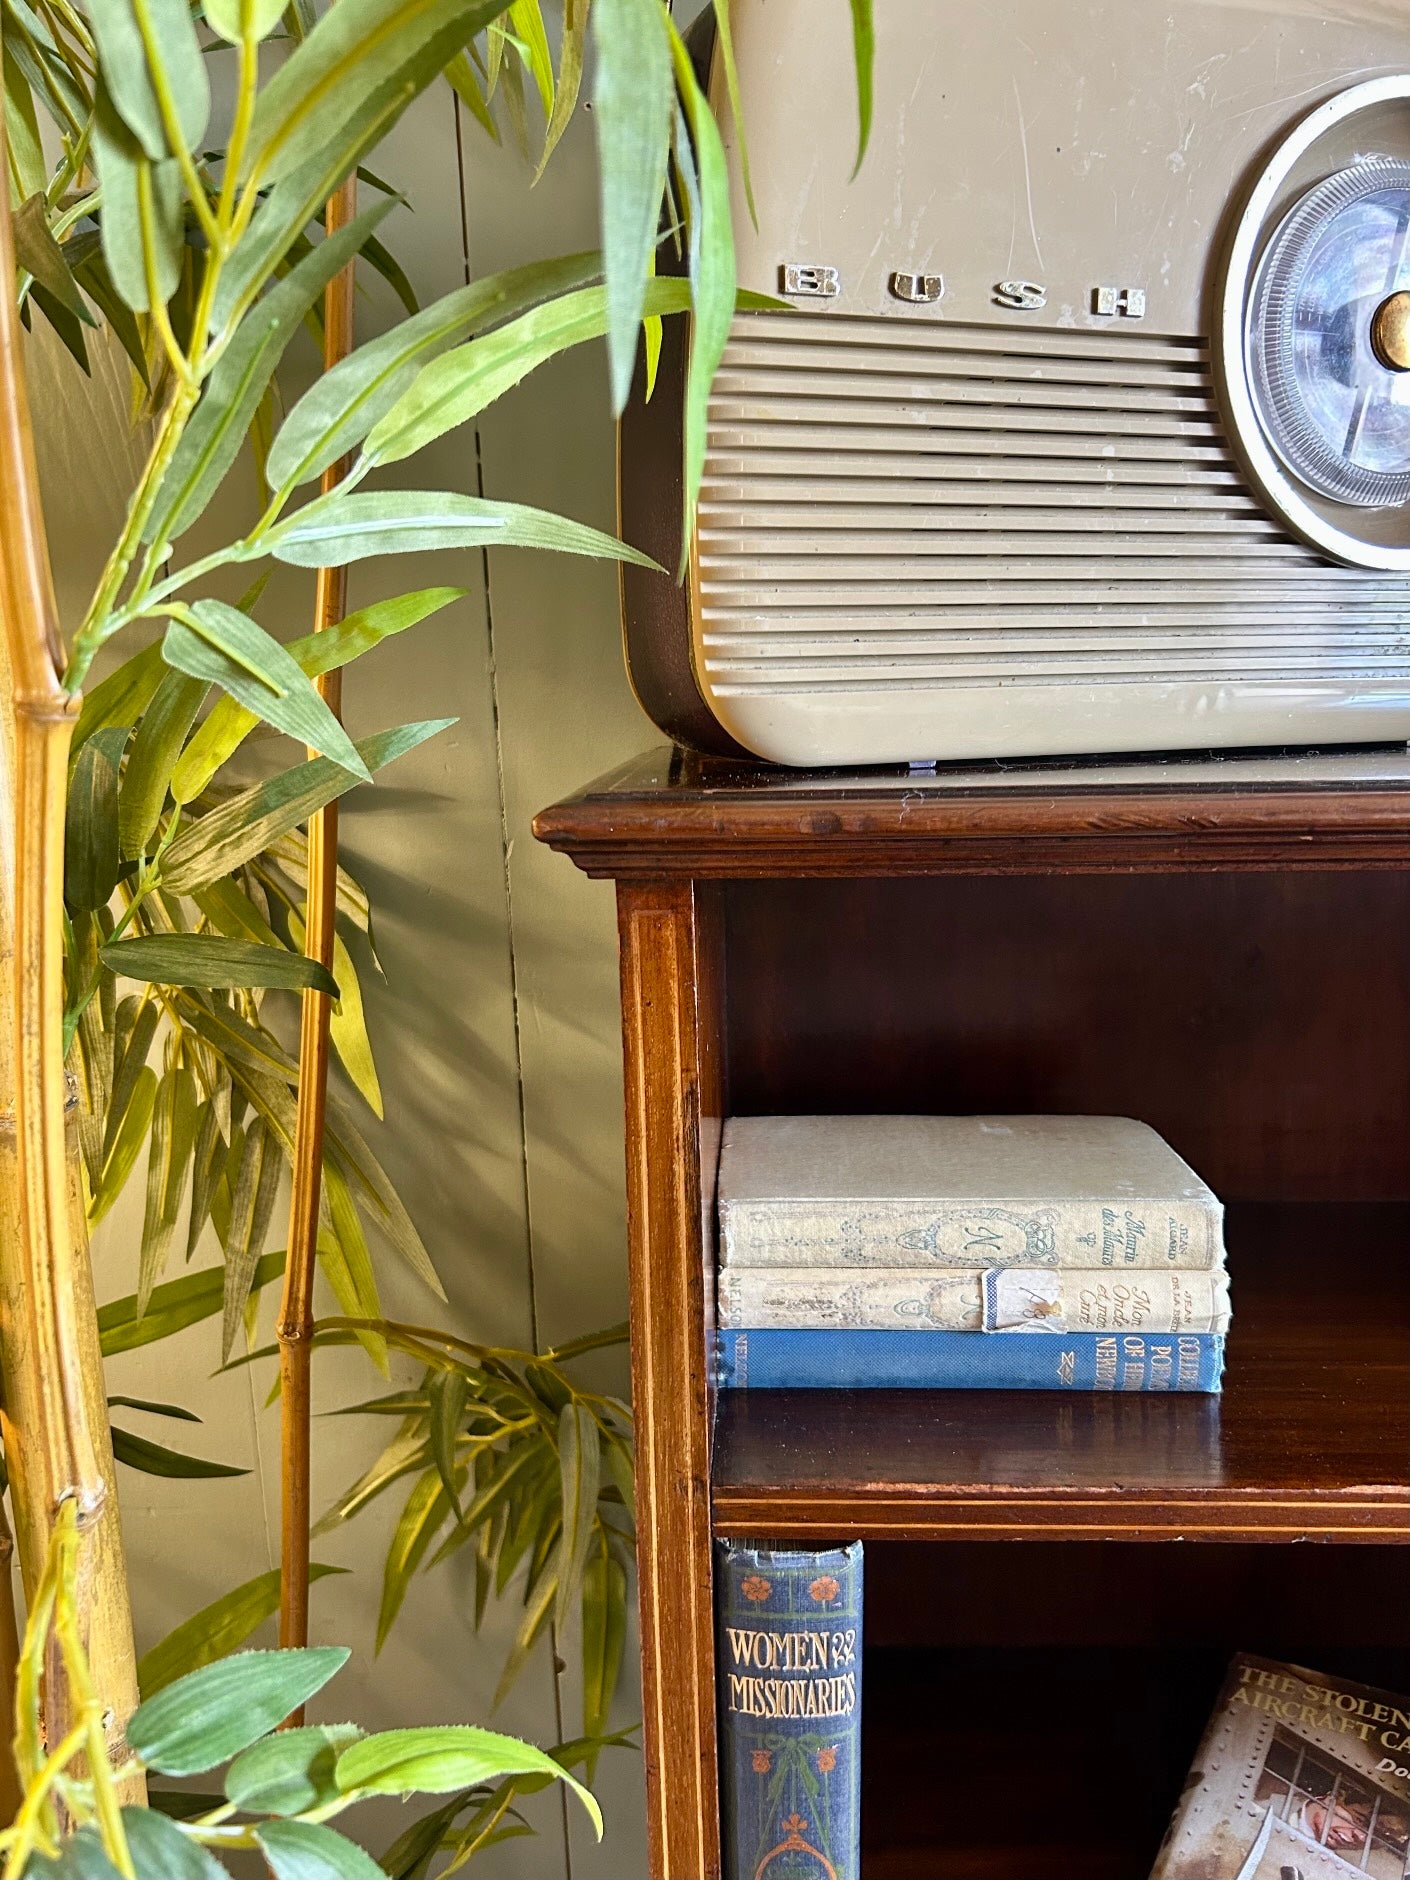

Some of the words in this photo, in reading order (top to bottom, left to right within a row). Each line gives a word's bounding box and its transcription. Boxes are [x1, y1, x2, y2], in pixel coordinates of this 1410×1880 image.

[778, 263, 1146, 318] BUSH
[1102, 1208, 1116, 1229] des
[1124, 1210, 1146, 1264] Maurin
[1112, 1284, 1130, 1328] Oncle
[1130, 1286, 1151, 1327] Mon
[1184, 1290, 1193, 1323] JEAN
[1124, 1337, 1145, 1357] OF
[726, 1628, 829, 1670] WOMEN
[727, 1673, 856, 1719] MISSIONARIES
[1229, 1687, 1378, 1742] AIRCRAFT
[1238, 1665, 1298, 1694] THE
[1302, 1683, 1410, 1732] STOLEN
[1374, 1757, 1410, 1782] Do
